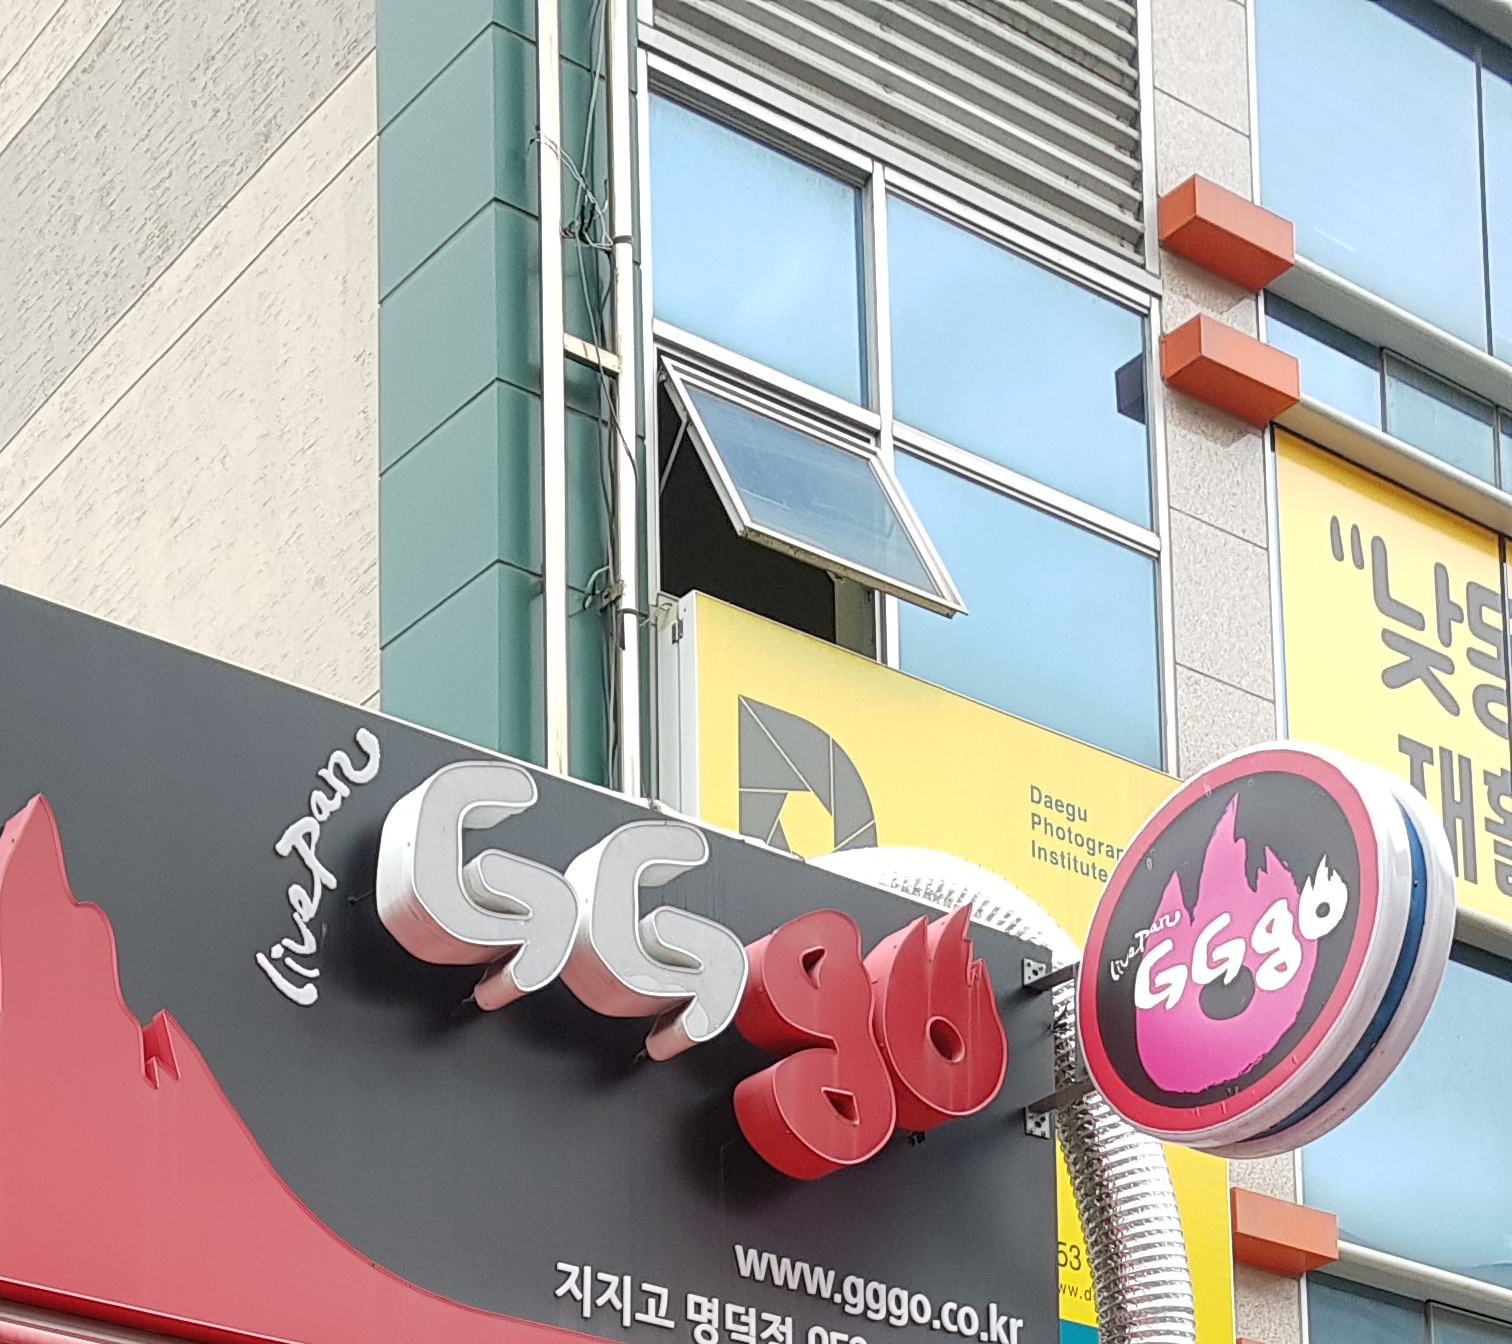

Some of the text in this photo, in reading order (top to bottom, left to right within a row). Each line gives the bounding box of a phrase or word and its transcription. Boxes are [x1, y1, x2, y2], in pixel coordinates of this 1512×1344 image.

[1030, 785, 1087, 822] Daegu
[257, 727, 380, 1005] livepan
[1032, 840, 1108, 883] Institute
[1110, 910, 1181, 981] livepan
[554, 1261, 675, 1329] 지지고
